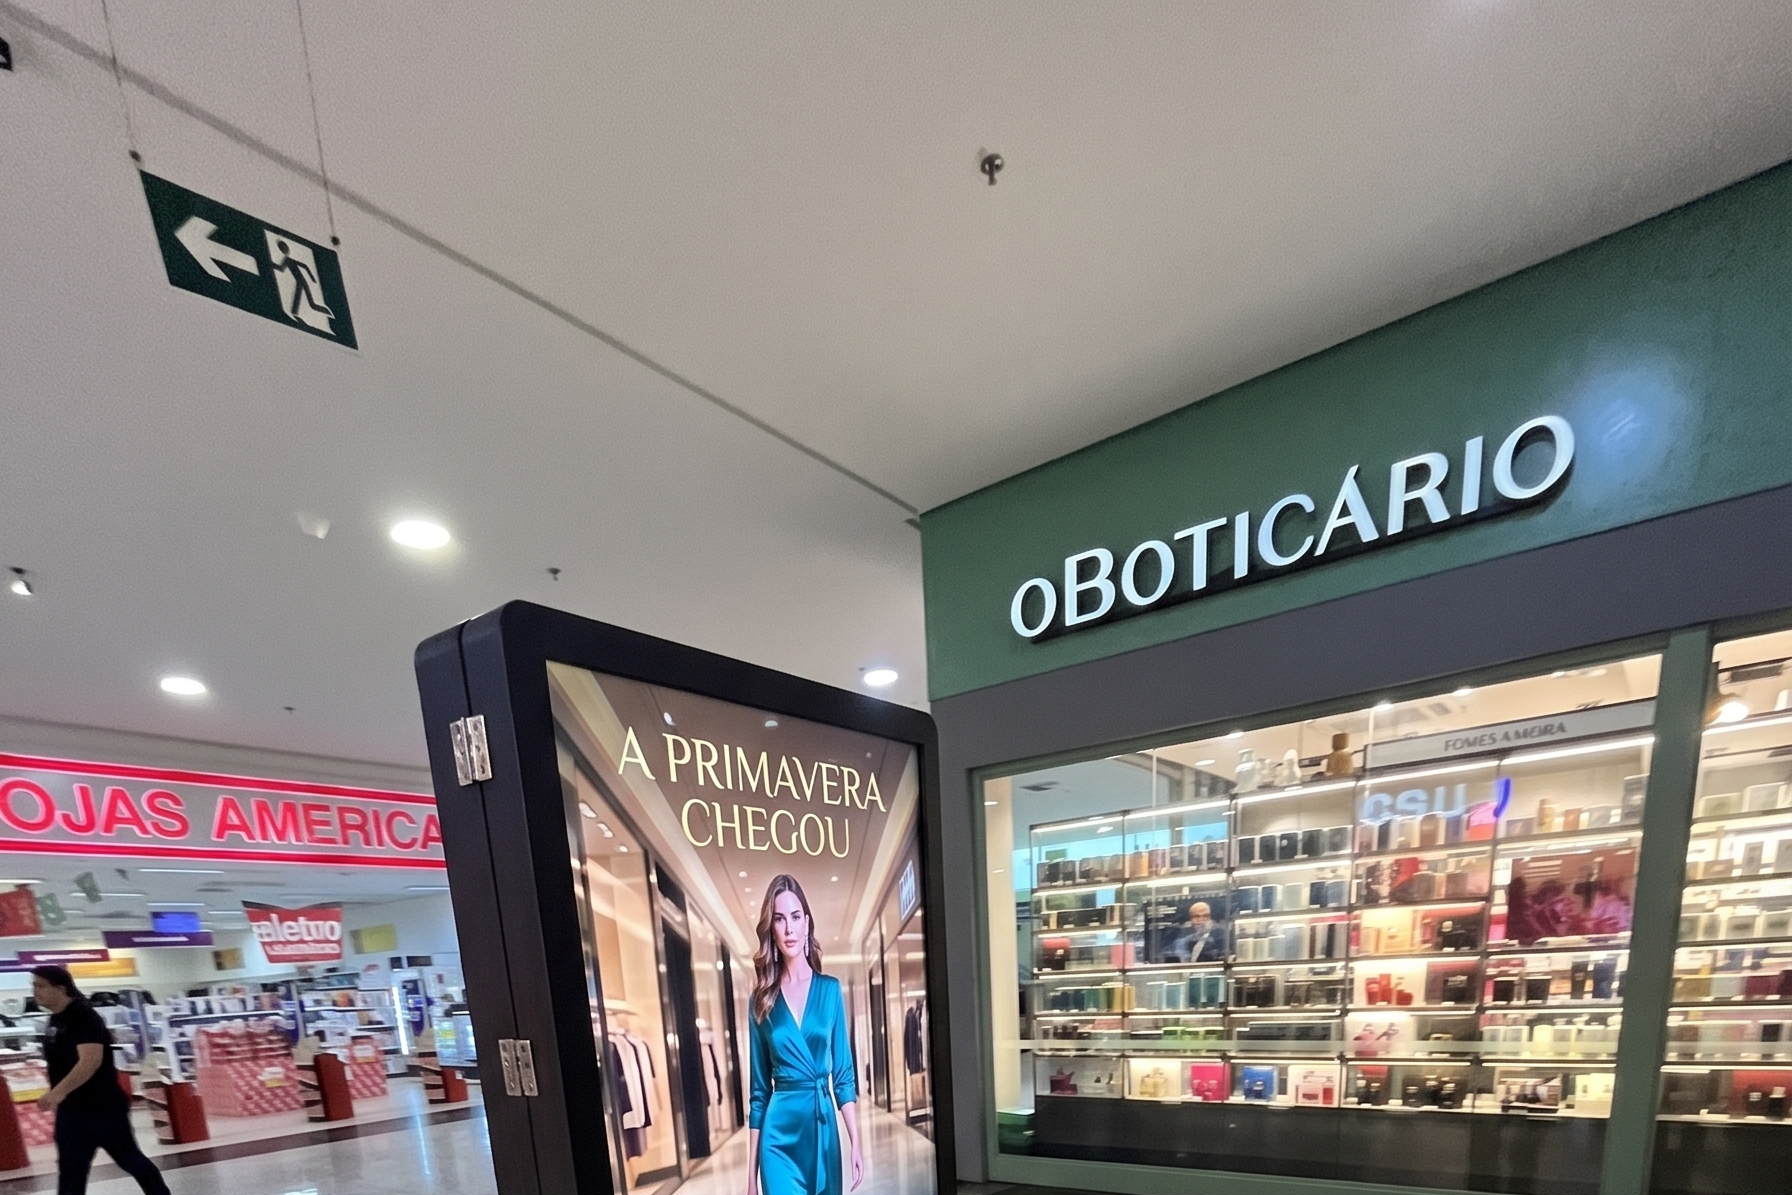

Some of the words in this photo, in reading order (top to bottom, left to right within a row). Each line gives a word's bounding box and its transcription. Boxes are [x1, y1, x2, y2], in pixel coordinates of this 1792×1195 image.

[618, 726, 656, 781] A
[662, 732, 887, 813] PRIMAVERA
[0, 777, 190, 840] OJAS
[681, 798, 850, 858] CHEGOU
